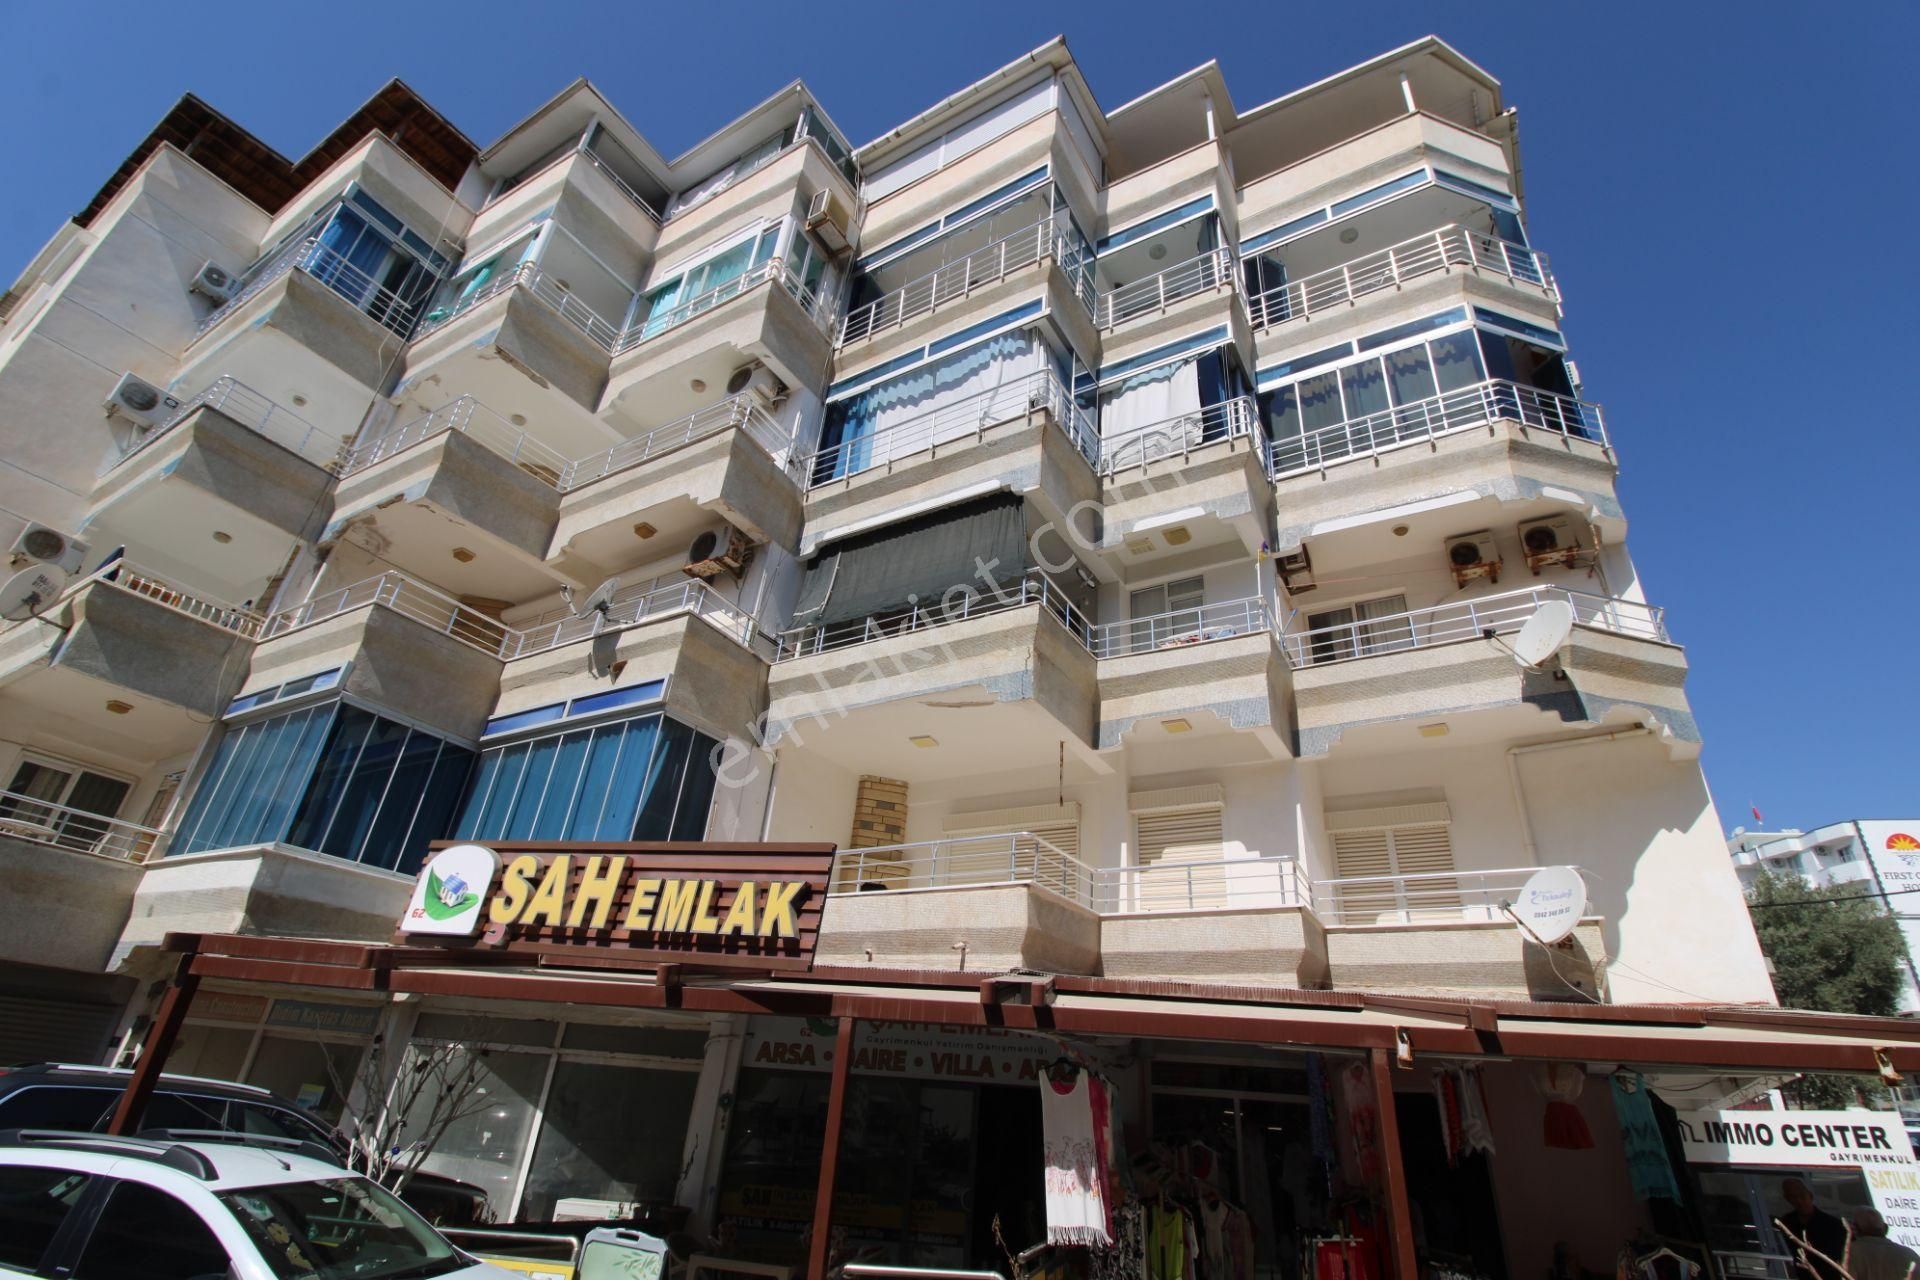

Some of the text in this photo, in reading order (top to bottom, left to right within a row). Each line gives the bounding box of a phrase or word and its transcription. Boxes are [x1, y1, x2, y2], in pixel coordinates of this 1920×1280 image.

[1884, 871, 1913, 880] FIRST
[411, 908, 426, 919] 62
[624, 879, 806, 937] EMLAK
[755, 1041, 816, 1066] ARSA
[1703, 1121, 1892, 1150] IMMO CENTER
